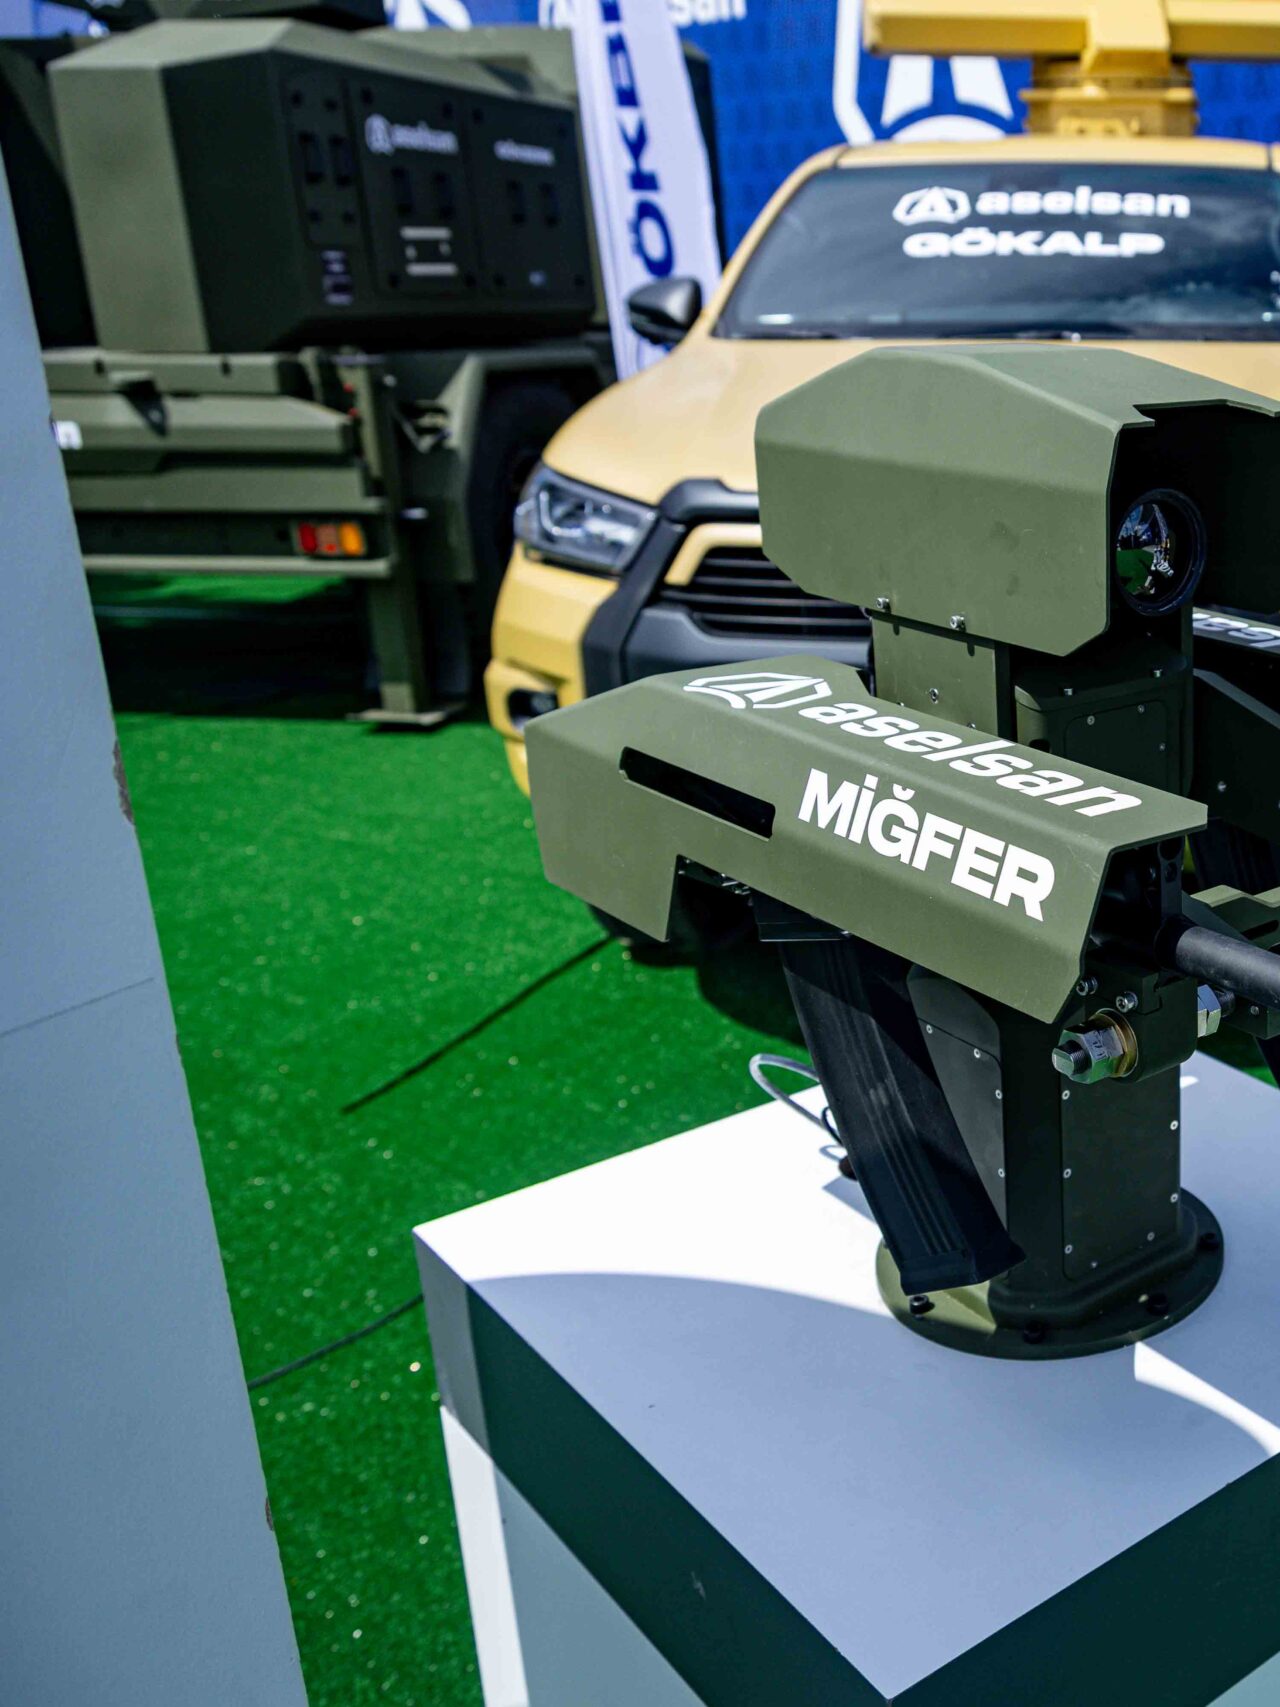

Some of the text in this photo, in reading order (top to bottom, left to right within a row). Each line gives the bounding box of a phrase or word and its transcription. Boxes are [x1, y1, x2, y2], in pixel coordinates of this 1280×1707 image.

[976, 185, 1191, 218] aselsan
[902, 226, 1166, 258] GÖKALP
[798, 702, 1143, 818] aselsan
[797, 767, 1056, 922] MİĞFER
